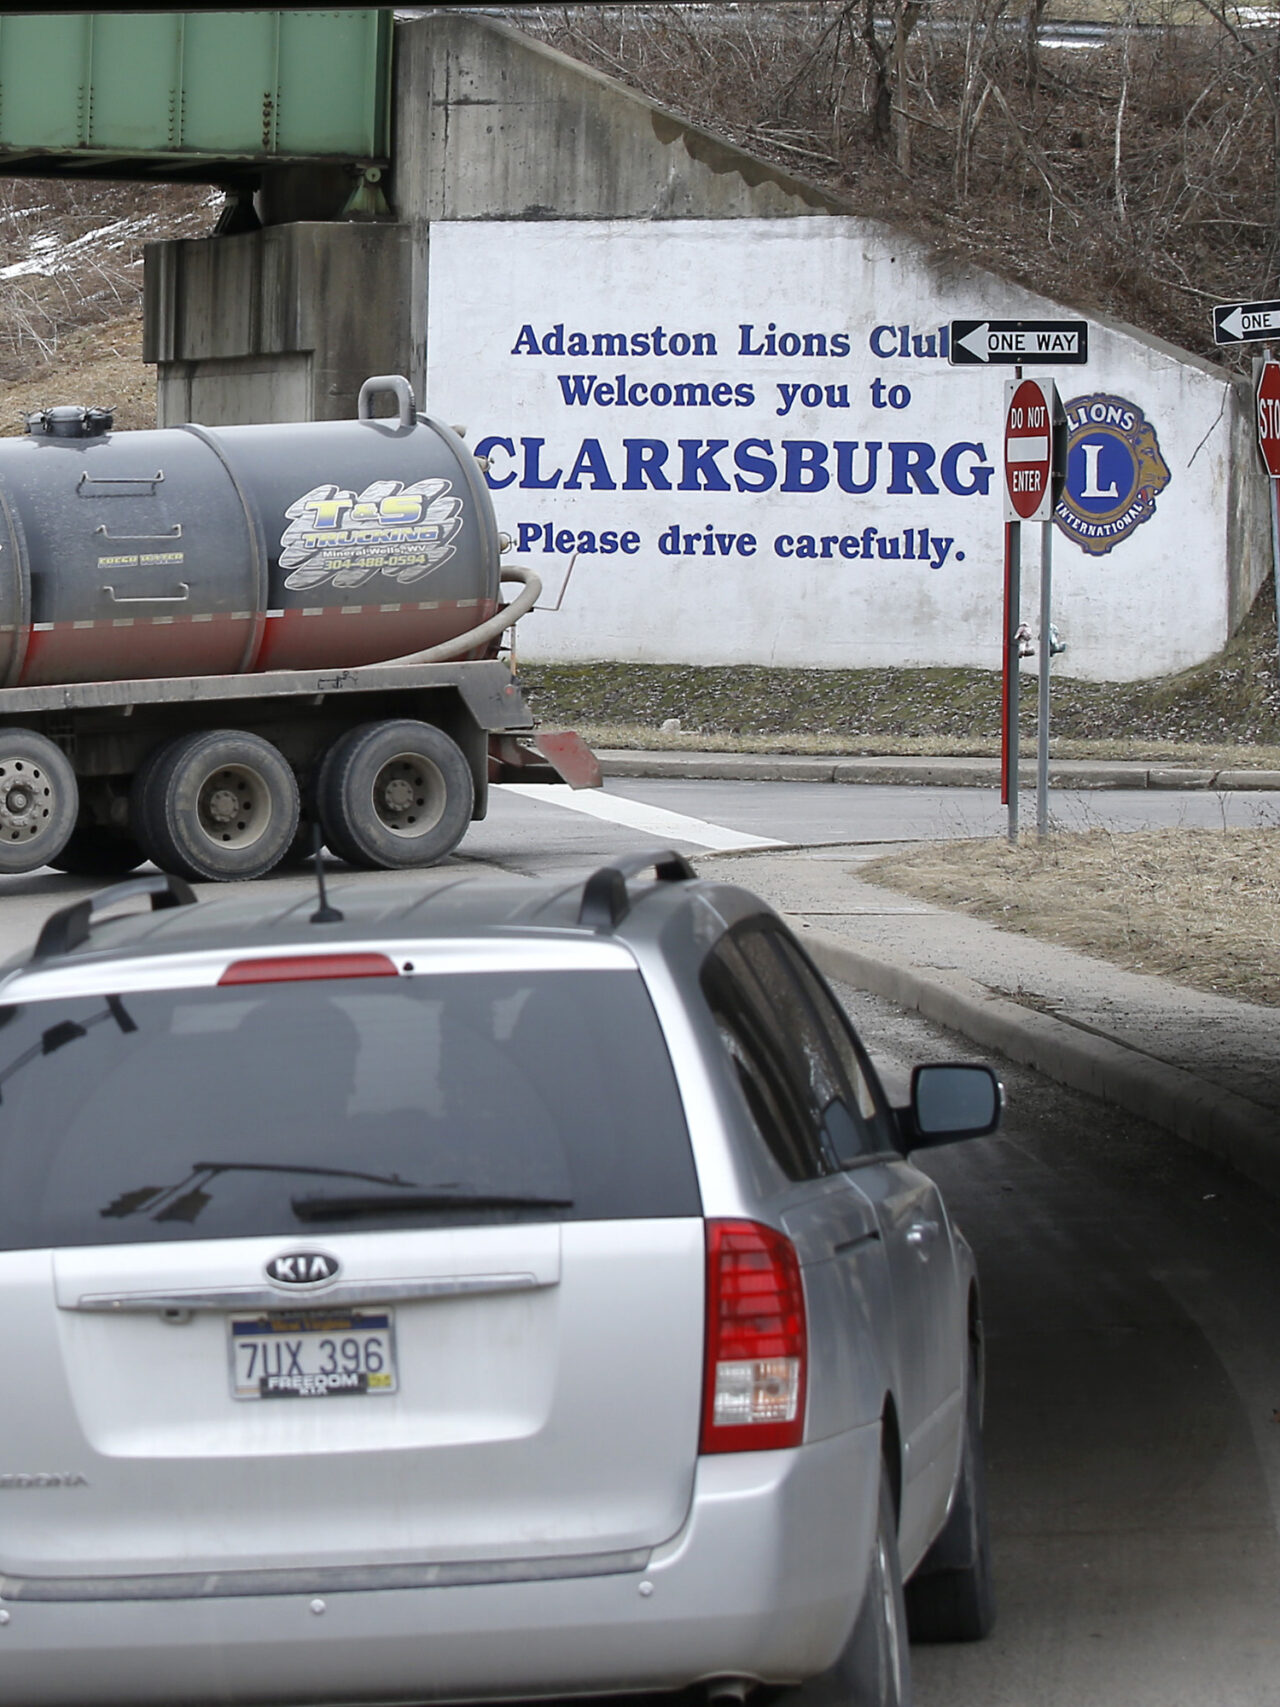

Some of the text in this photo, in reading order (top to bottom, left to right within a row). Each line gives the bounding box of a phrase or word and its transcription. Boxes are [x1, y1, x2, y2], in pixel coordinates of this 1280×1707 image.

[1242, 314, 1272, 330] ONE
[511, 324, 717, 356] Adamston
[738, 323, 851, 357] Lions
[988, 334, 1076, 351] ONE WAY
[557, 374, 911, 416] Welcomes you to
[1011, 406, 1045, 428] DO NOT
[1067, 403, 1135, 432] LIONS
[1260, 398, 1280, 439] STO
[474, 436, 995, 495] CLARKSBURG
[1080, 444, 1119, 498] L
[1013, 470, 1041, 493] ENTER
[1055, 502, 1143, 537] INTERNATIONAL
[302, 525, 440, 548] TRUCKING
[517, 522, 966, 569] Please drive carefully.
[323, 549, 366, 558] Mineral
[406, 545, 426, 553] WV
[323, 554, 426, 571] 304-488-0594
[275, 1257, 330, 1282] KIA
[239, 1338, 384, 1379] 7UX 396
[268, 1374, 359, 1389] FREEDOM
[299, 1386, 327, 1395] KIA
